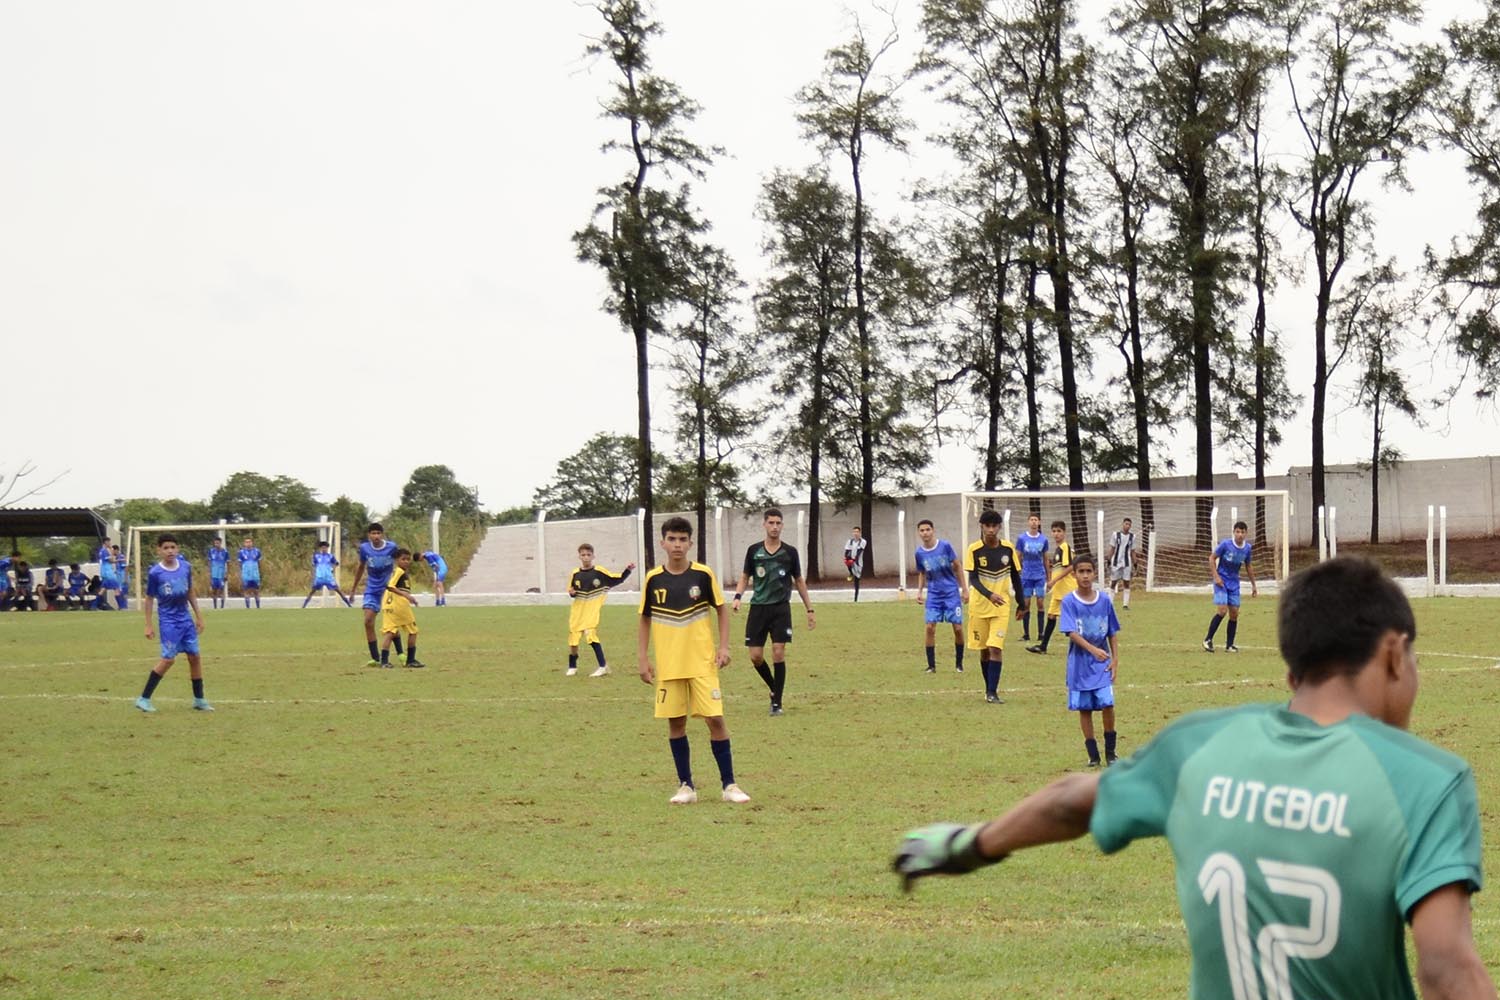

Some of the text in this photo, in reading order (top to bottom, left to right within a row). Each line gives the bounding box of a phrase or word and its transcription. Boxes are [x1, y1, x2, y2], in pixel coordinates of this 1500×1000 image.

[653, 588, 668, 604] 17
[955, 606, 961, 617] 8
[1202, 776, 1352, 837] FUTEBOL
